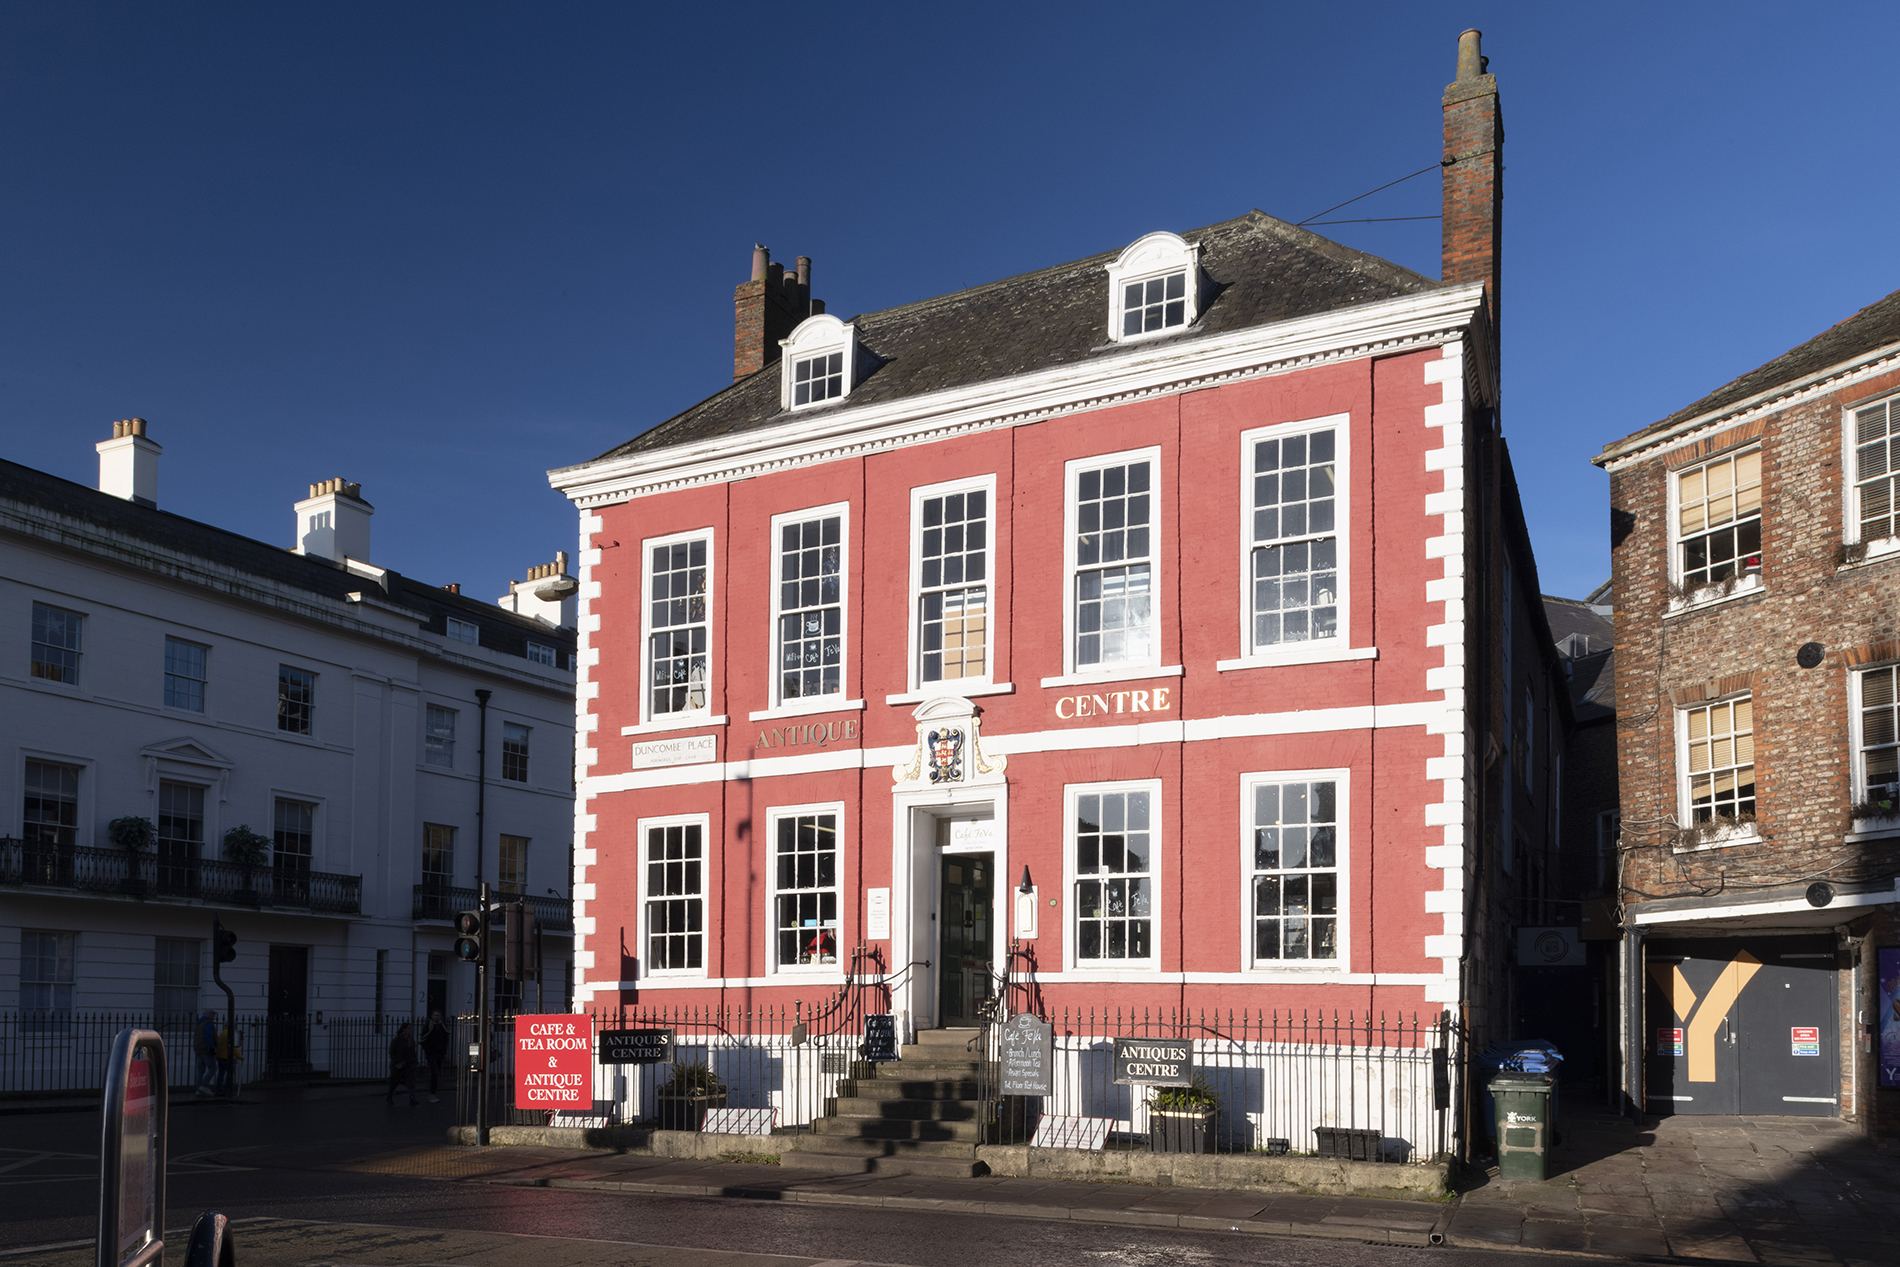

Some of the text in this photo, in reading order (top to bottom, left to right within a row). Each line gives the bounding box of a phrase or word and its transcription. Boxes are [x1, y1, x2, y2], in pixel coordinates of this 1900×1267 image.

[1055, 687, 1170, 719] CENTRE
[755, 720, 859, 750] ANTIQUE
[634, 739, 713, 756] DUNCOMBE PLACE
[530, 1023, 576, 1036] CAFE &
[519, 1038, 587, 1050] TEA ROOM
[605, 1034, 668, 1047] ANTIQUES
[611, 1047, 662, 1059] CENTRE
[1120, 1046, 1186, 1062] ANTIQUES
[548, 1056, 558, 1068] &
[1032, 1058, 1041, 1068] Tea
[1021, 1068, 1039, 1078] Specials
[1126, 1062, 1180, 1077] CENTRE
[524, 1073, 583, 1089] ANTIQUE
[527, 1088, 580, 1101] CENTRE
